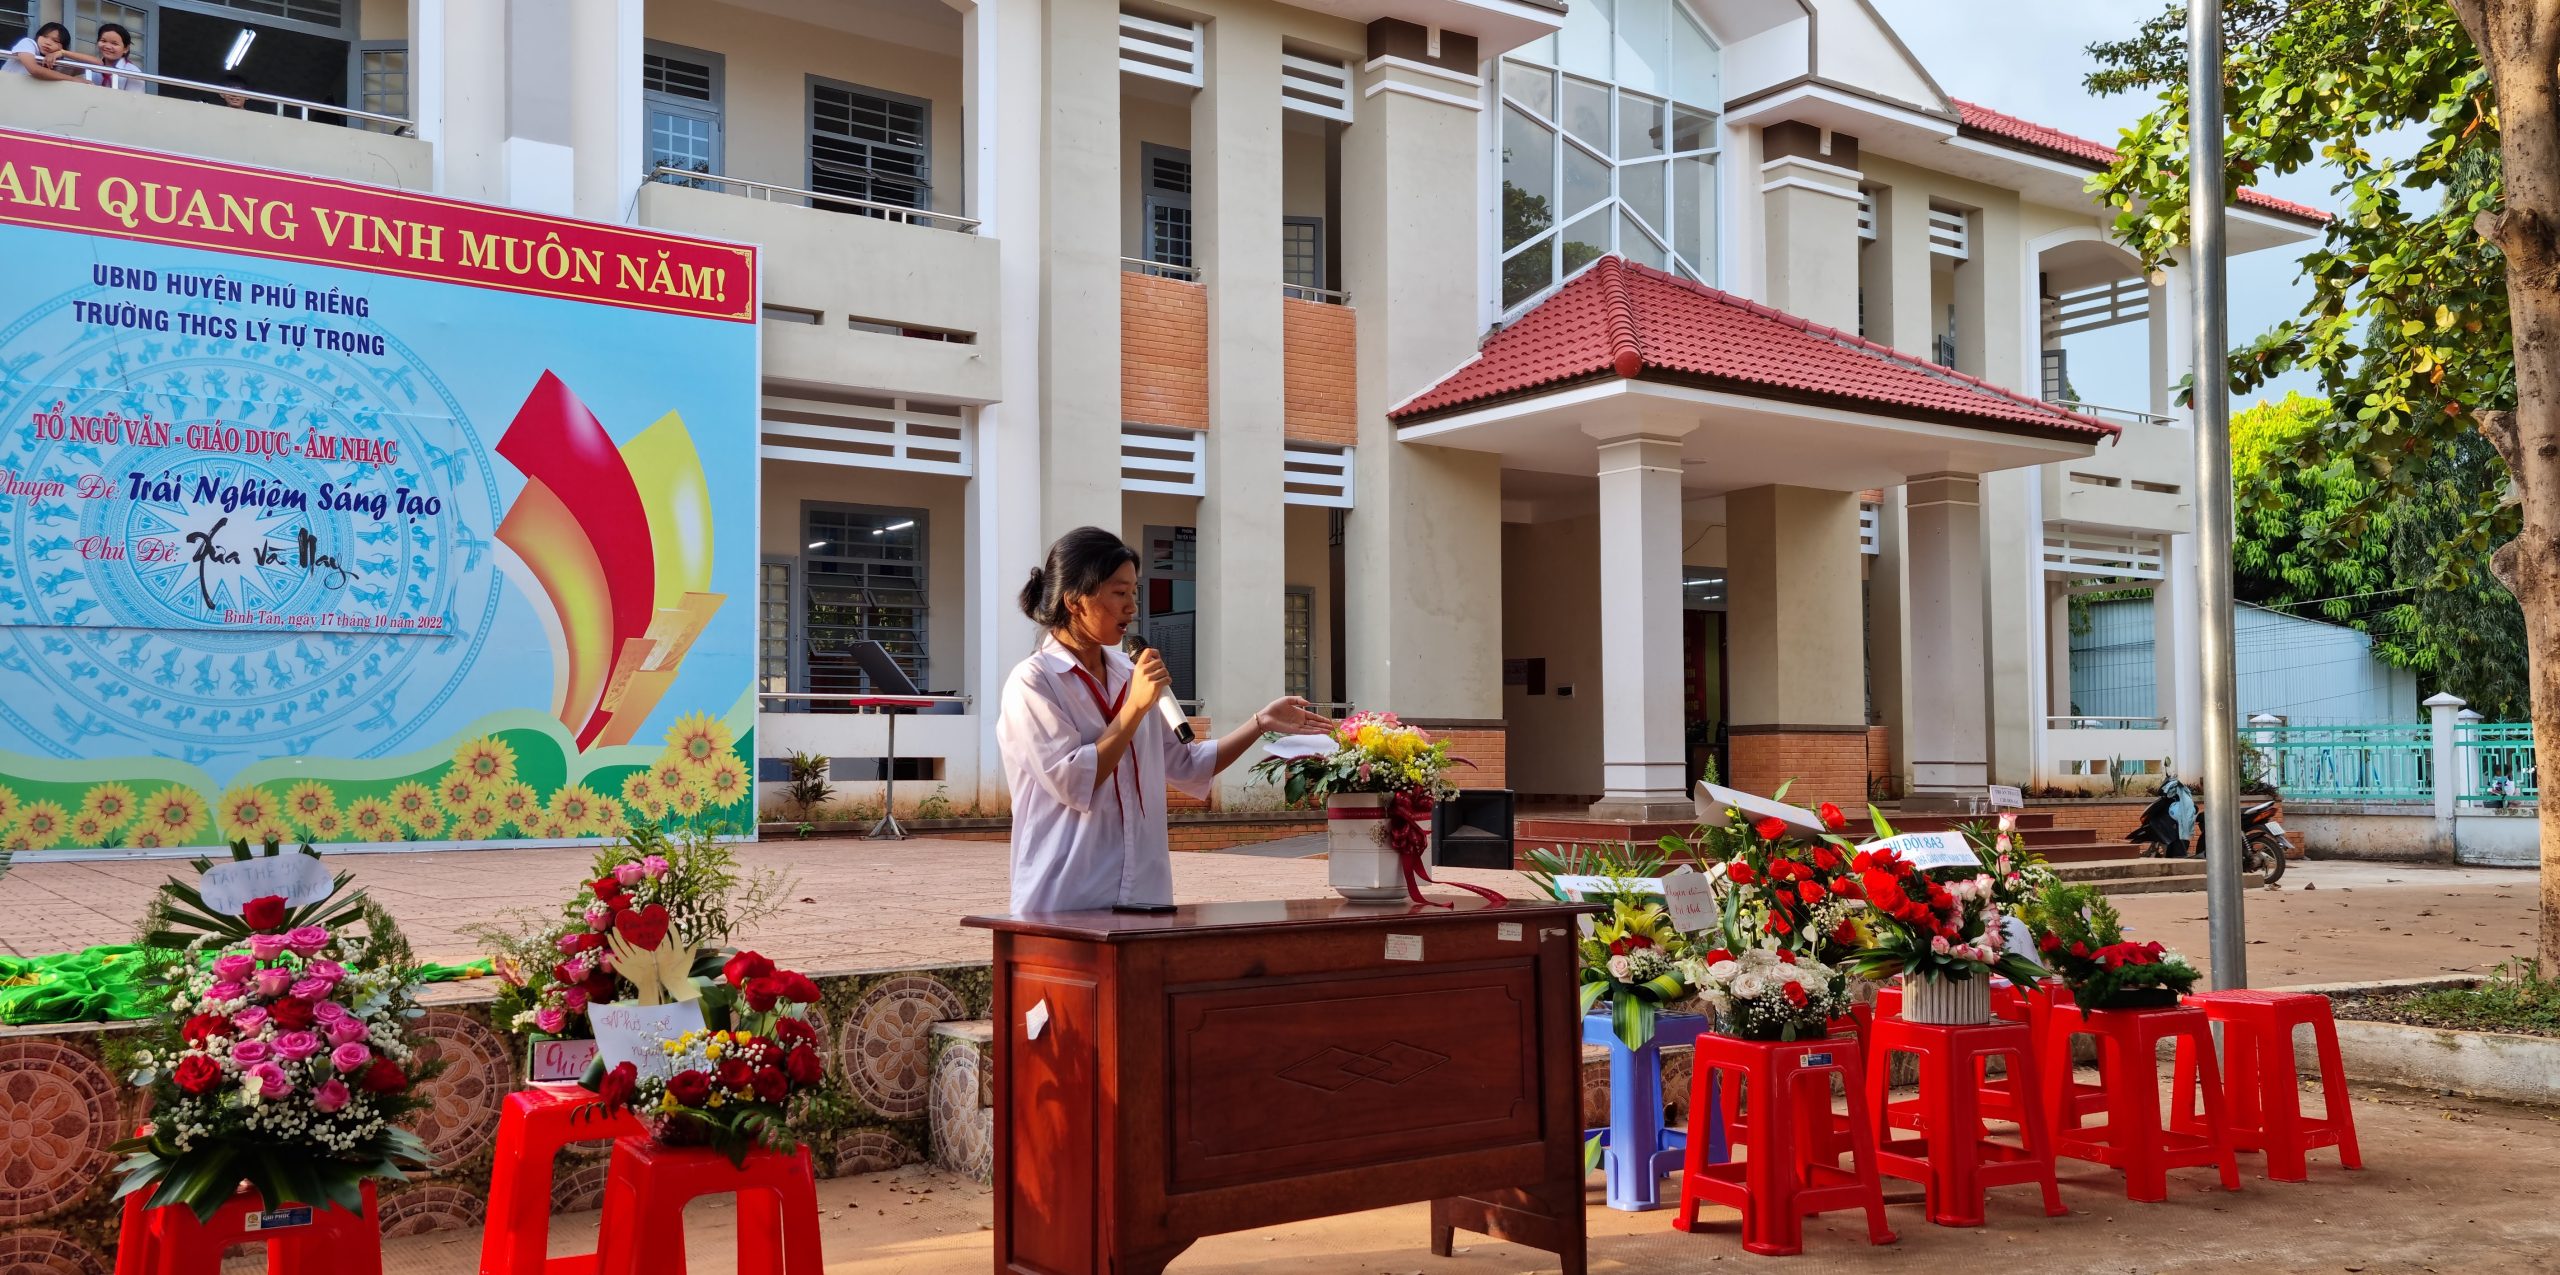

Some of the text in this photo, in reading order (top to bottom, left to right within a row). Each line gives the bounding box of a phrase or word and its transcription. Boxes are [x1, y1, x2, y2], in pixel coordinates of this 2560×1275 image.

[97, 177, 299, 241] QUANG
[311, 207, 445, 263] VINH
[458, 229, 604, 285] MUÔN
[616, 249, 727, 303] NĂM!
[93, 264, 369, 318] UBND HUYỆN PHÚ RIỀNG
[73, 300, 385, 357] TRƯỜNG THCS LÝ TỰ TRỌNG
[33, 400, 65, 441] TỔ
[70, 412, 121, 445] NGỮ
[124, 414, 171, 447] VĂN
[186, 419, 241, 451] GIÁO
[245, 429, 290, 462] DỤC
[304, 426, 338, 460] ÂM
[340, 437, 397, 470] NHẠC
[77, 474, 118, 500] Đề:
[129, 470, 182, 502] Trải
[193, 476, 306, 517] Nghiệm
[318, 482, 387, 521] Sáng
[396, 487, 441, 524] Tạo
[74, 535, 125, 561] Chủ
[137, 538, 177, 562] Đề:
[298, 527, 360, 590] Nay
[224, 610, 443, 630] Bình Tân, ngày 17 tháng 10 năm 2022
